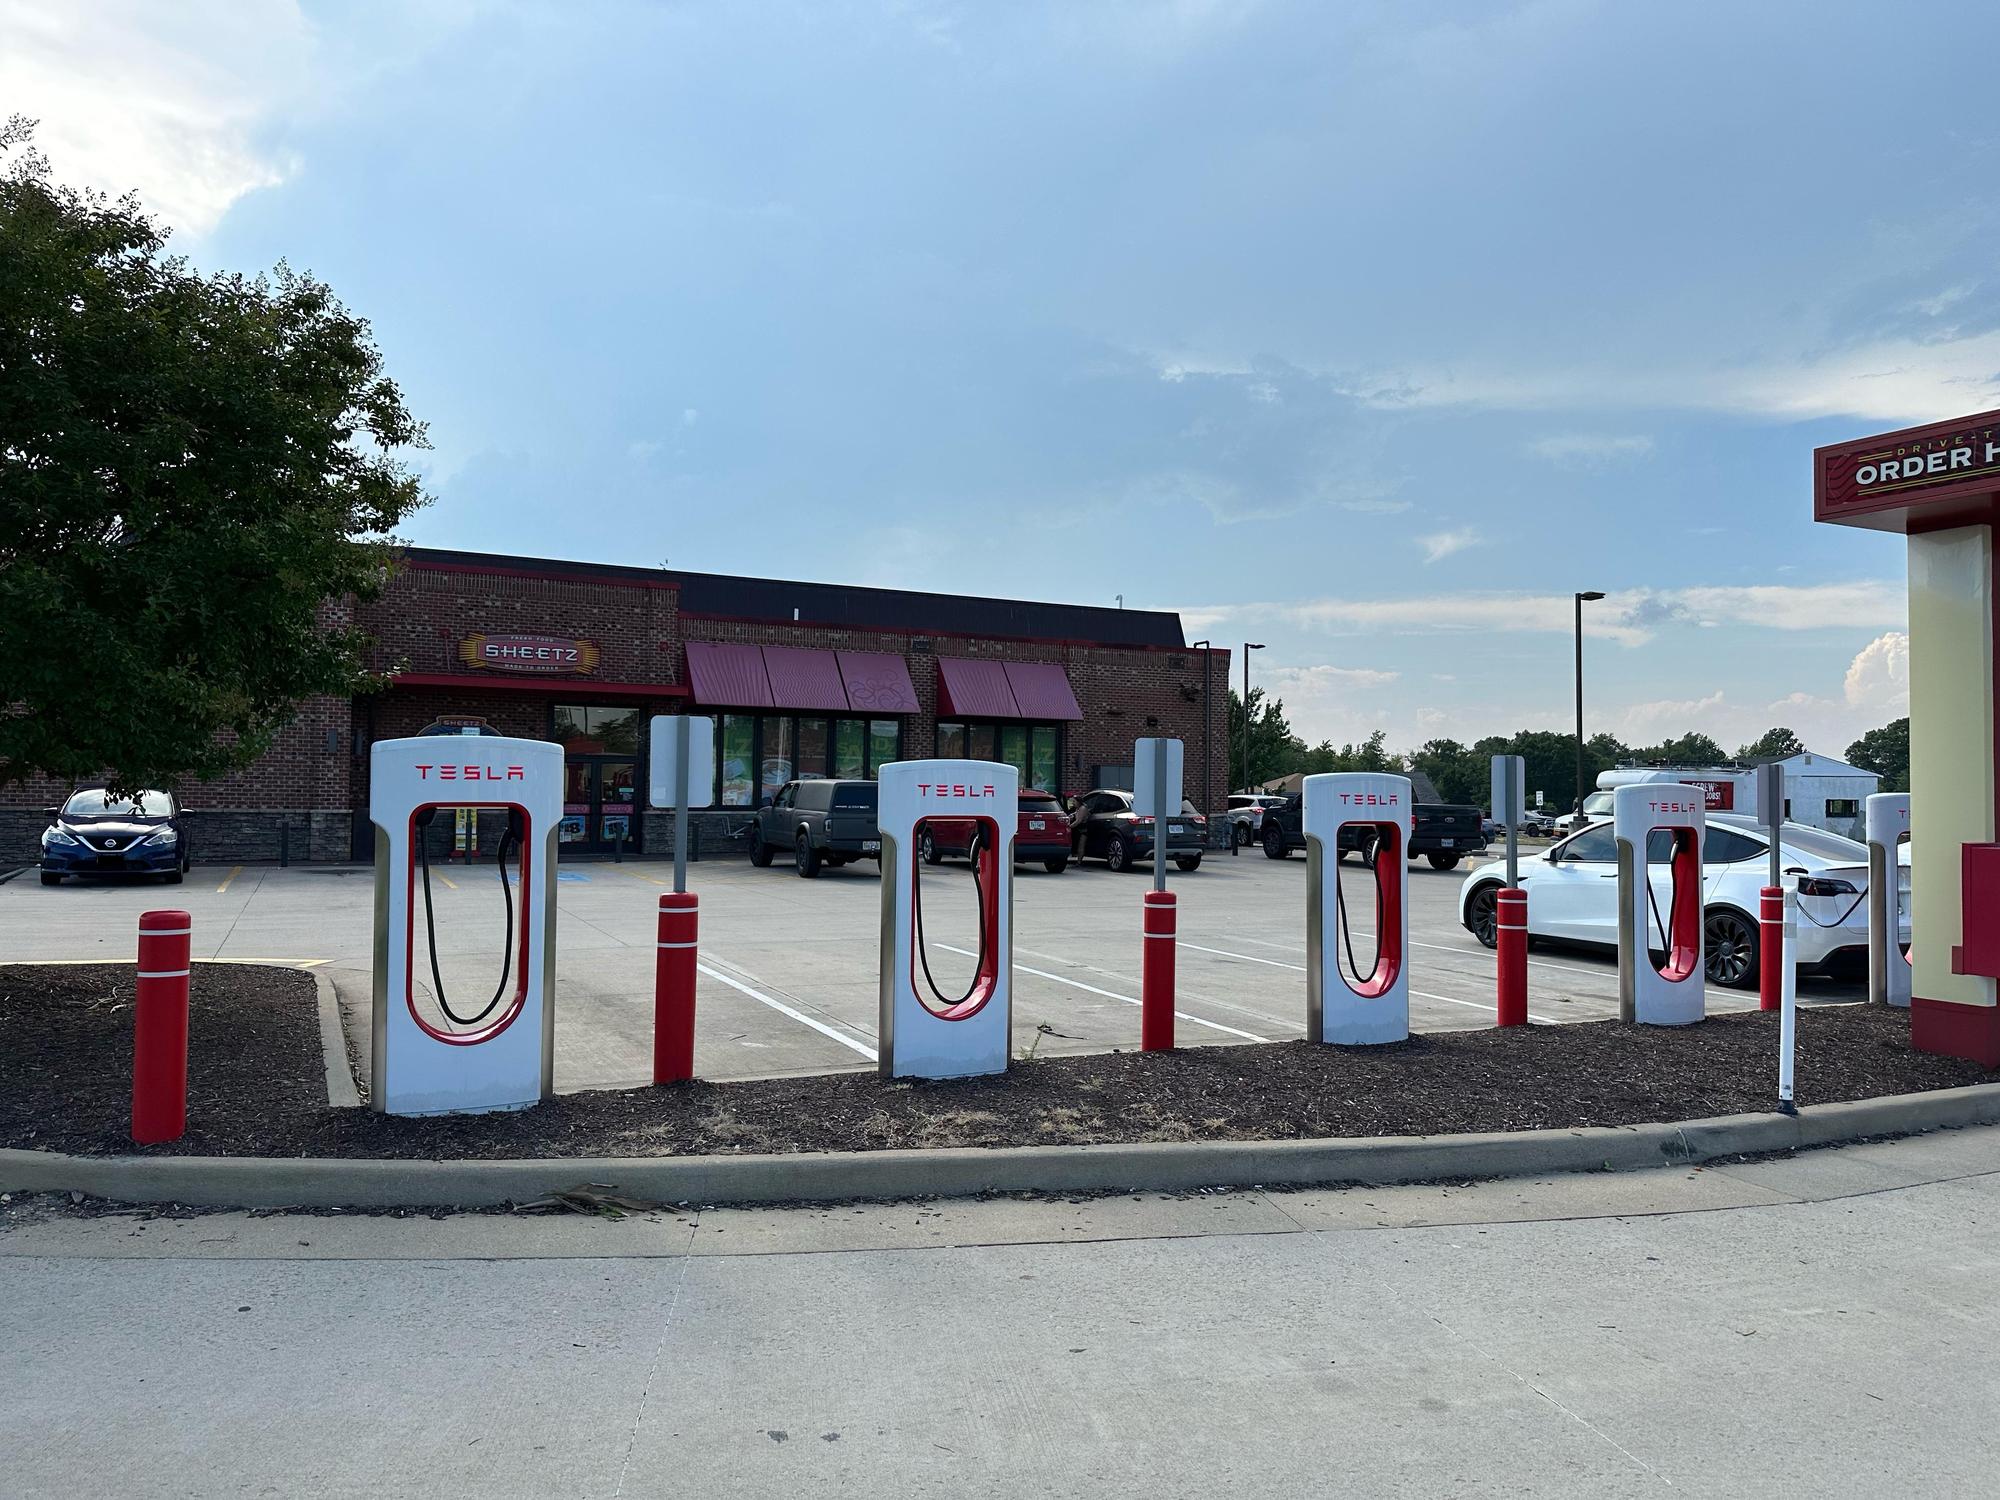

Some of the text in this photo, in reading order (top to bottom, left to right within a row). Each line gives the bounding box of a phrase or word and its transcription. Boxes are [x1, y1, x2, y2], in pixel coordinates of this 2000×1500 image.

[1897, 430, 1993, 456] DRIVE-T
[1855, 447, 1972, 485] ORDER
[485, 644, 578, 661] SHEETZ
[415, 765, 524, 780] TESLA
[917, 784, 995, 797] TESLA
[1339, 794, 1398, 806] TESLA
[1649, 802, 1696, 813] TESLA
